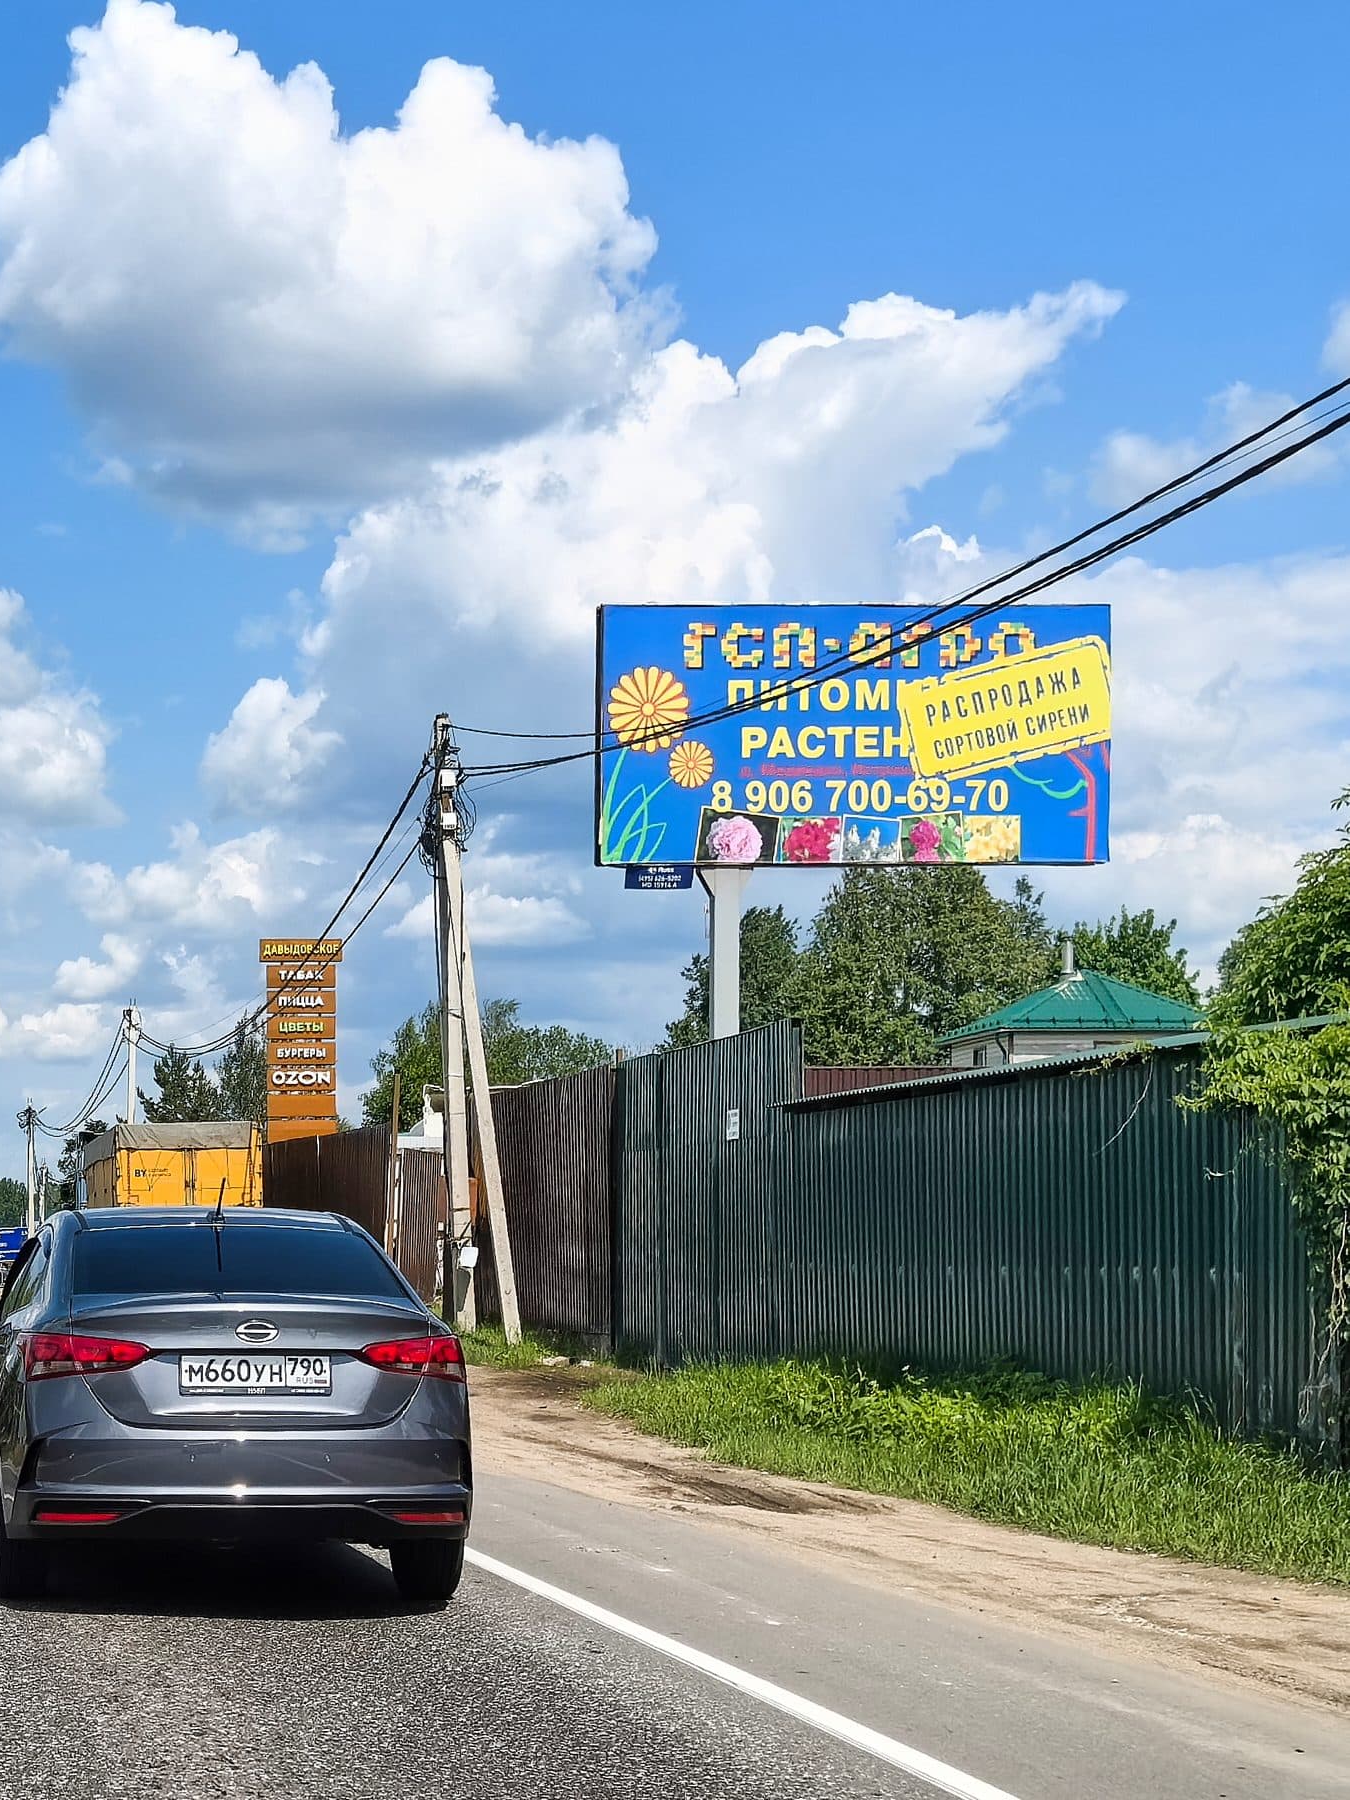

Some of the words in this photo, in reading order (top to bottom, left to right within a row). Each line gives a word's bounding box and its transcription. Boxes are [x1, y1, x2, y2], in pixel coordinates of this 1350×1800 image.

[925, 667, 1082, 727] РАСПРОДАЖА
[933, 718, 1019, 760] СОРТОВОЙ
[1025, 703, 1091, 736] СИРЕНИ
[711, 780, 733, 812] 8
[745, 780, 812, 813] 906
[825, 779, 1010, 813] 700-69-70
[278, 996, 325, 1008] ПИЦЦА
[279, 1021, 324, 1033] ЦВЕТЫ
[276, 1047, 326, 1058] БУРГЕРЫ
[272, 1070, 331, 1085] OZON
[188, 1358, 283, 1383] М660УН
[287, 1357, 324, 1376] 790
[296, 1376, 314, 1384] RUS
